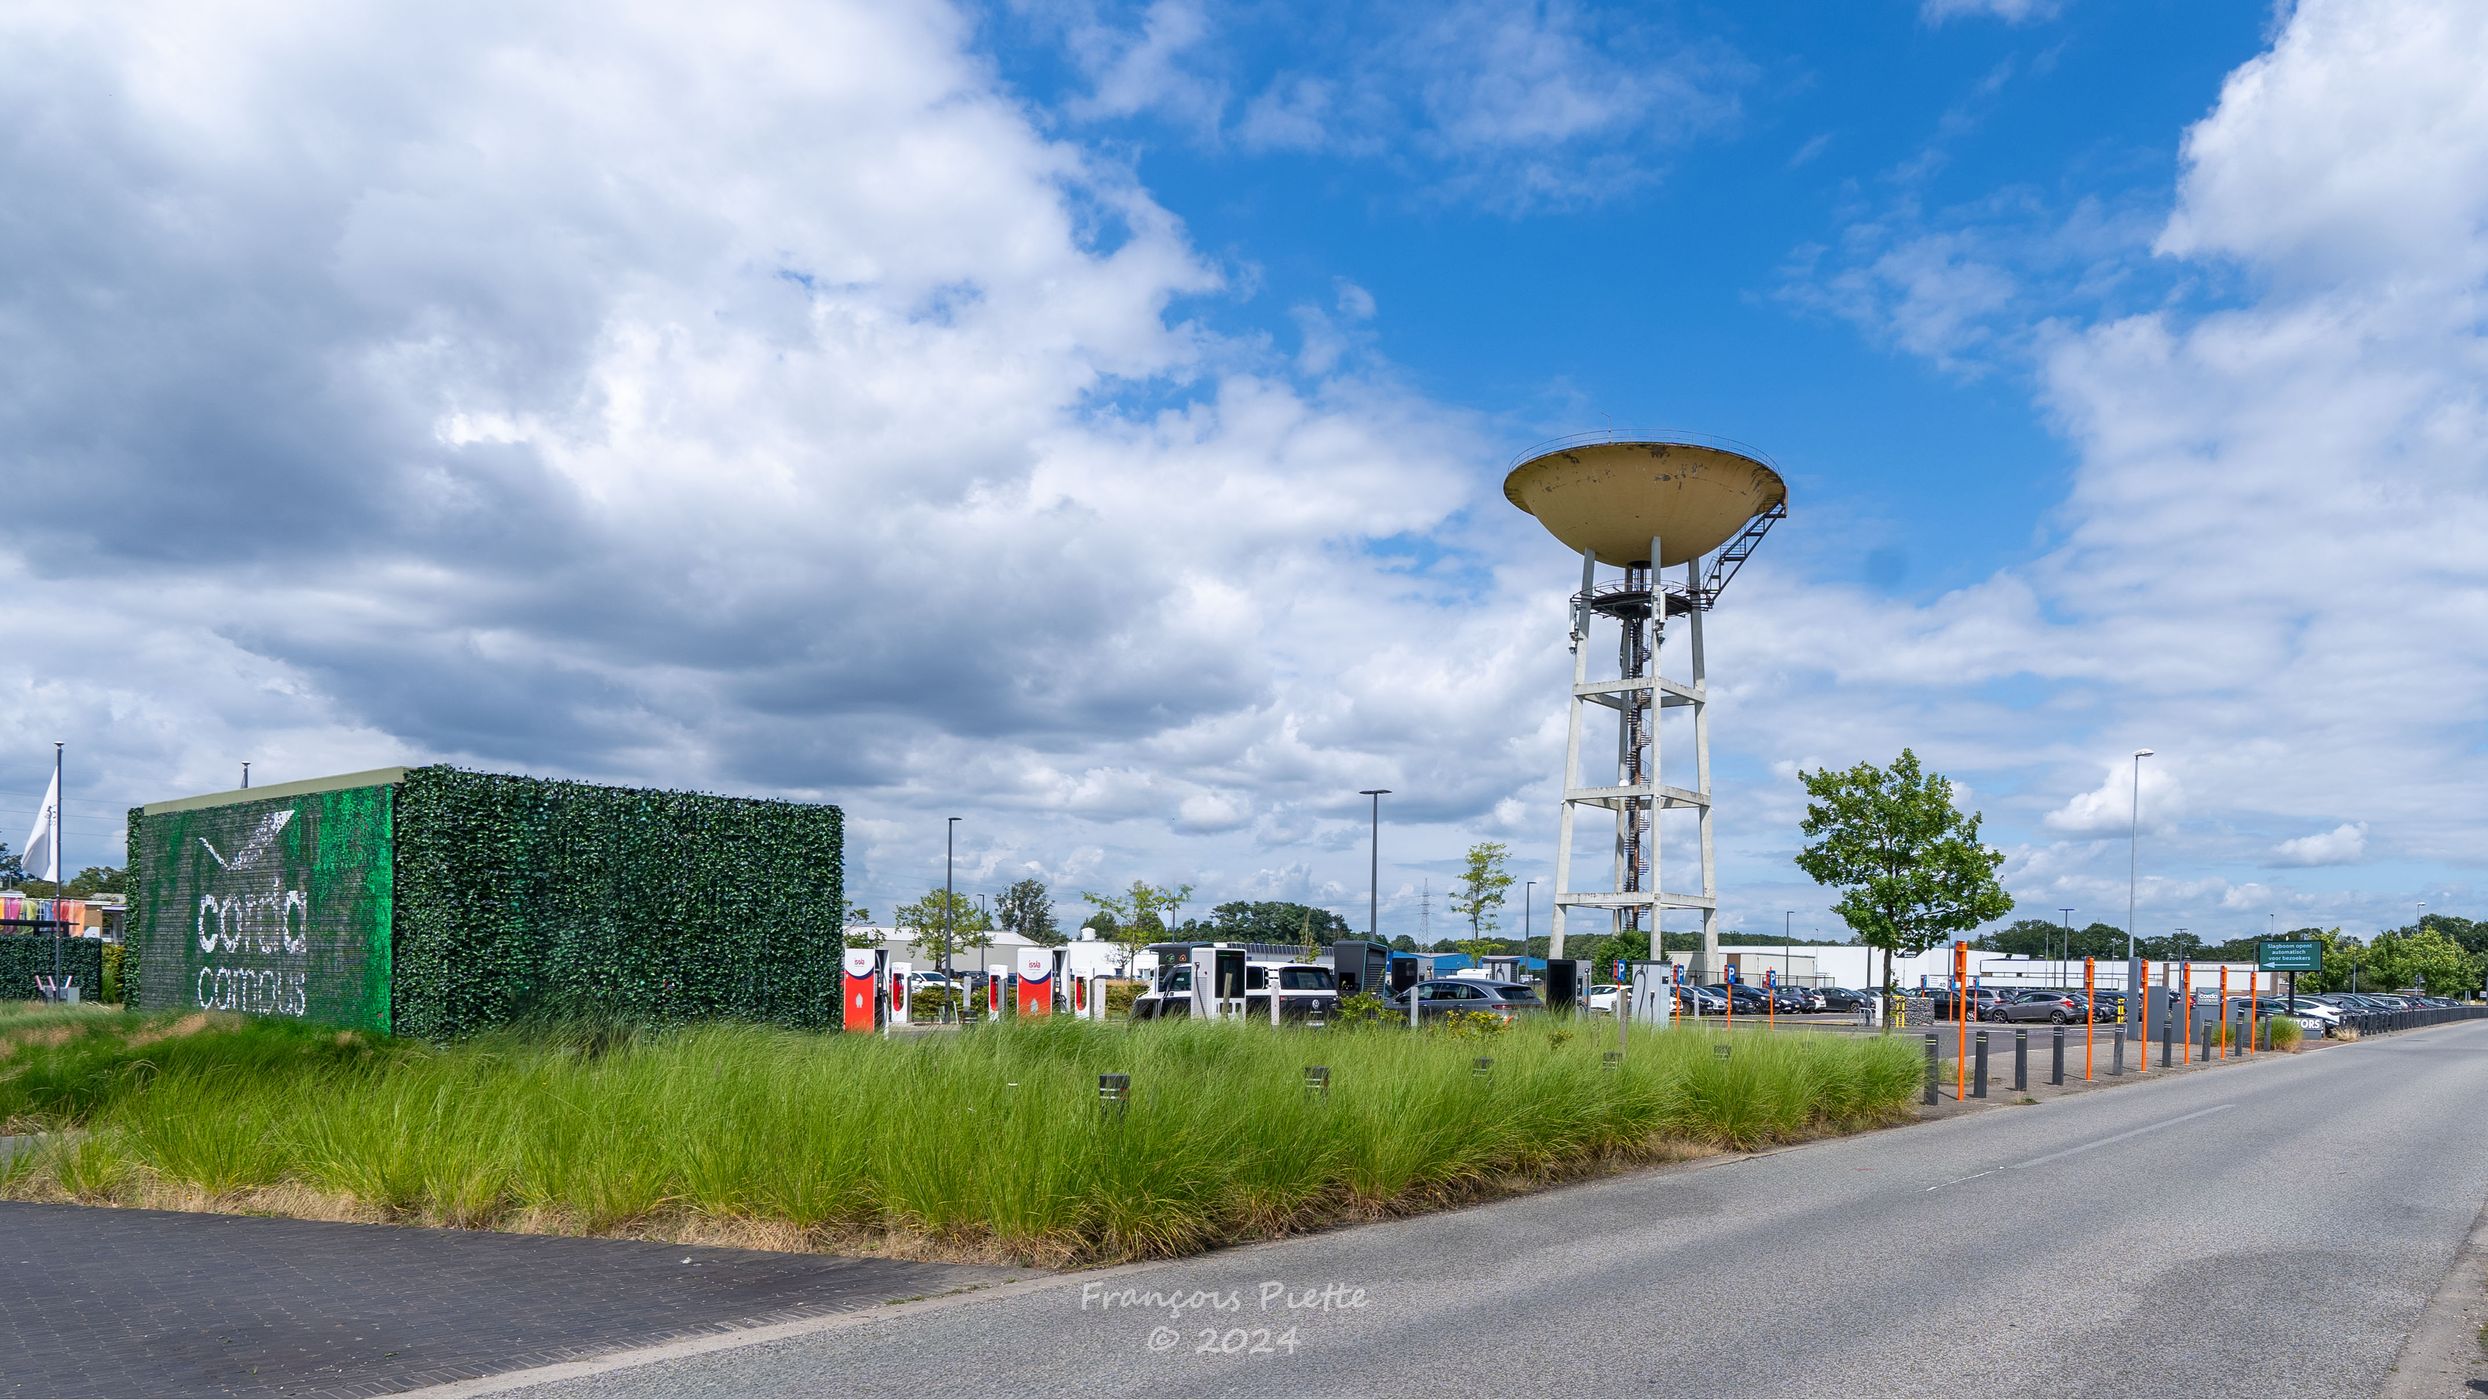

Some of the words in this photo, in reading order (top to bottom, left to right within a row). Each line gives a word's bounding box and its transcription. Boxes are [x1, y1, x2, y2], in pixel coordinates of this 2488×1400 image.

[198, 875, 307, 954] corda
[1618, 963, 1625, 978] P
[1678, 967, 1684, 982] P
[1728, 967, 1735, 981] P
[1770, 972, 1776, 986] P
[198, 966, 306, 1017] campus
